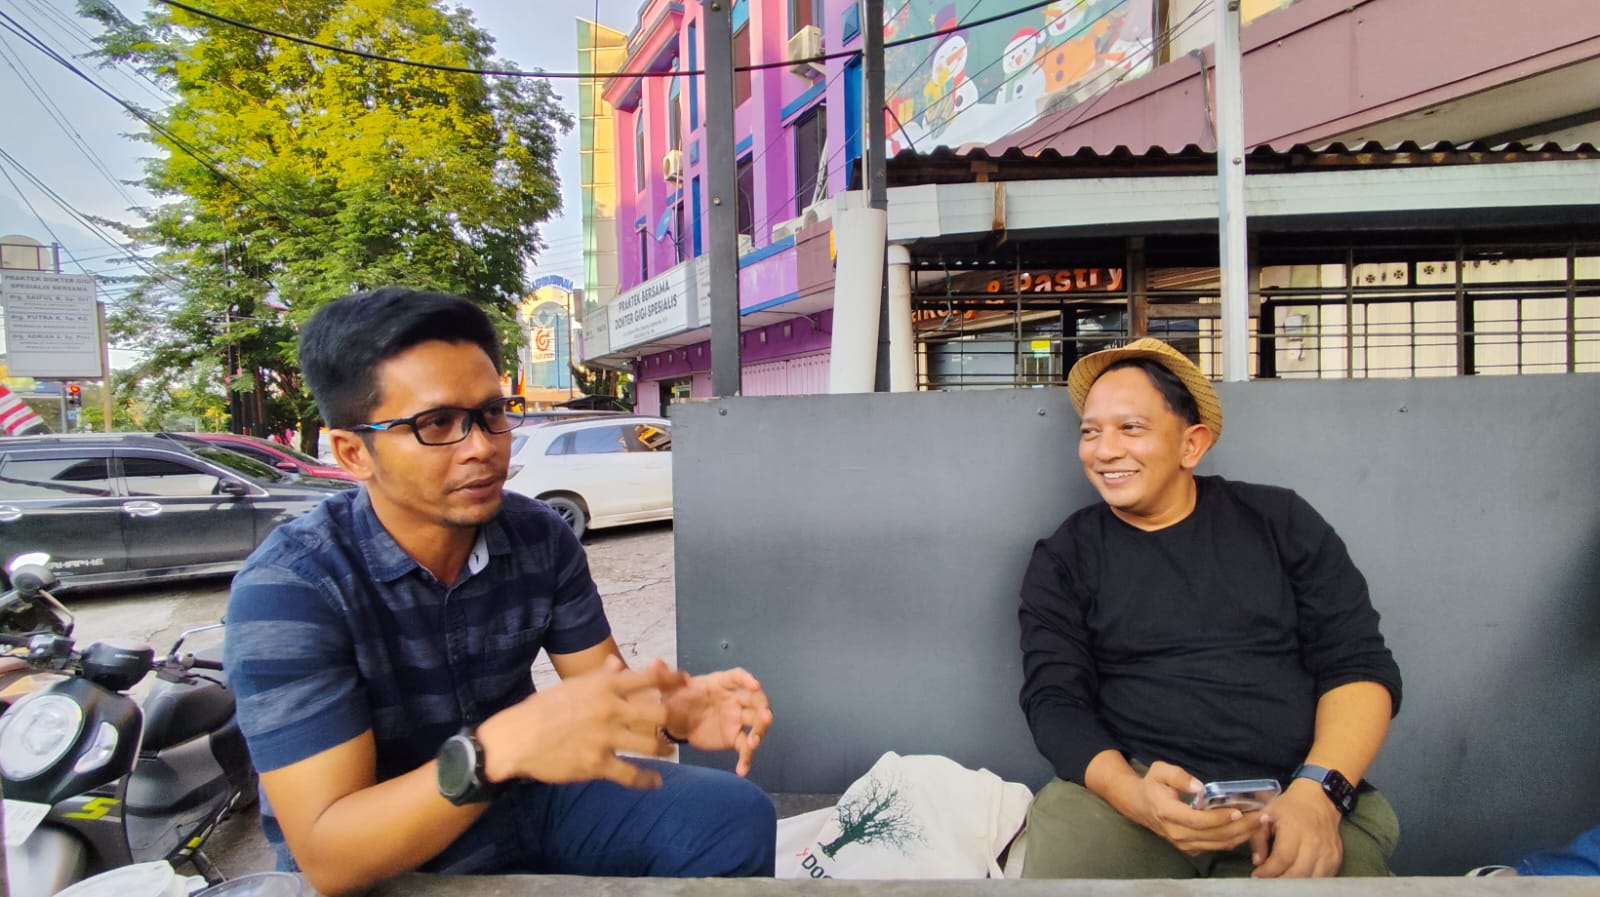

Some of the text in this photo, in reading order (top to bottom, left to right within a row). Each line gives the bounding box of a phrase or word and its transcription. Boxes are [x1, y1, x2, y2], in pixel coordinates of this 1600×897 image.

[614, 312, 633, 330] DOKTER
[634, 306, 647, 322] GIGI
[647, 293, 678, 317] SPESIALIS
[618, 279, 670, 312] PRAKTEK BERSAMA
[801, 853, 833, 879] DO
